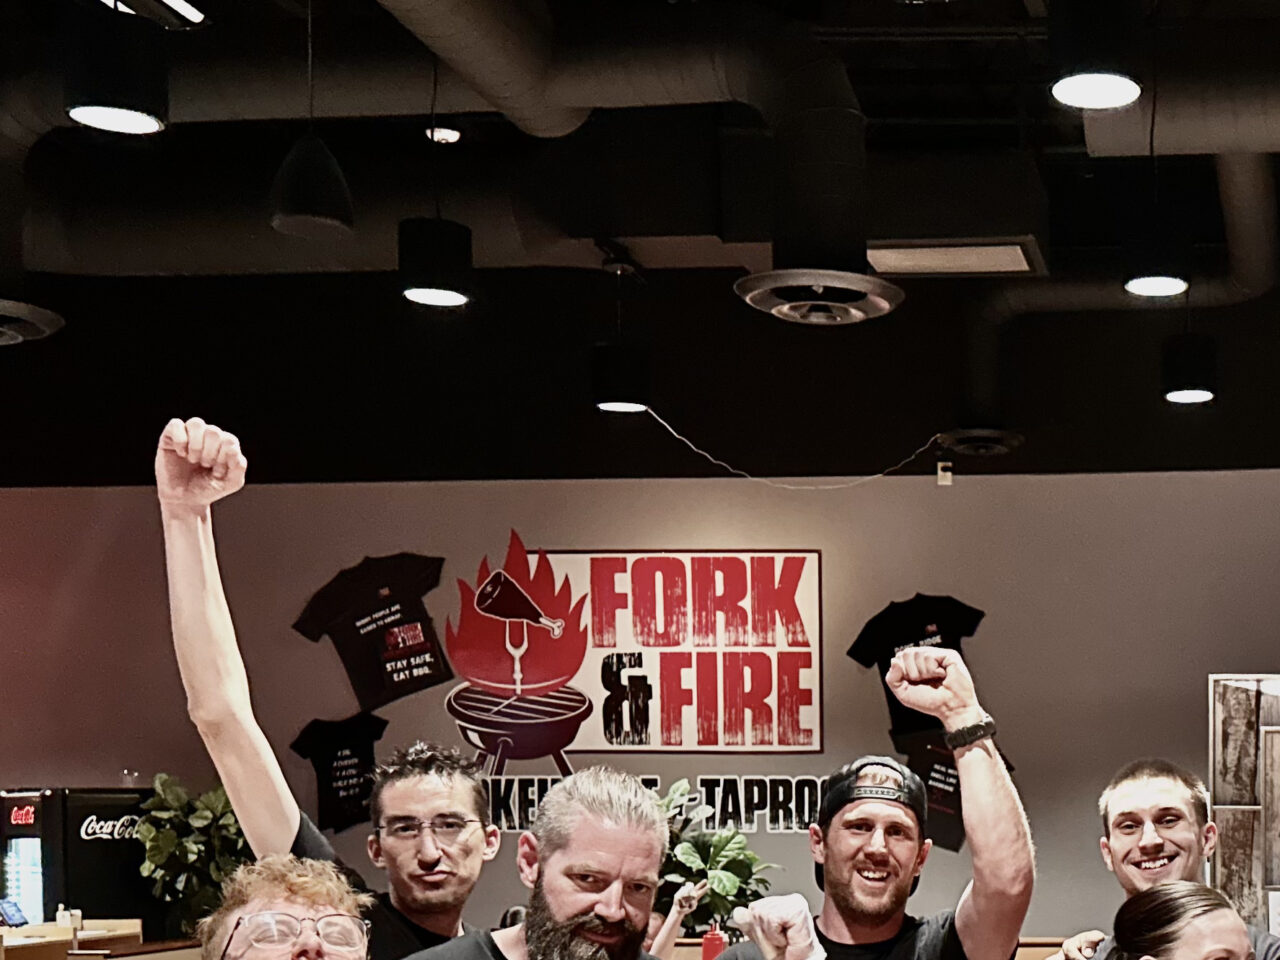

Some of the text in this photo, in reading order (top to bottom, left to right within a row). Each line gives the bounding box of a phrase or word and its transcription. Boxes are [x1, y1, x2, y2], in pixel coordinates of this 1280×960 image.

[589, 557, 811, 648] FORK
[386, 660, 408, 672] STAY
[393, 670, 410, 682] EAT
[601, 651, 813, 746] & FIRE
